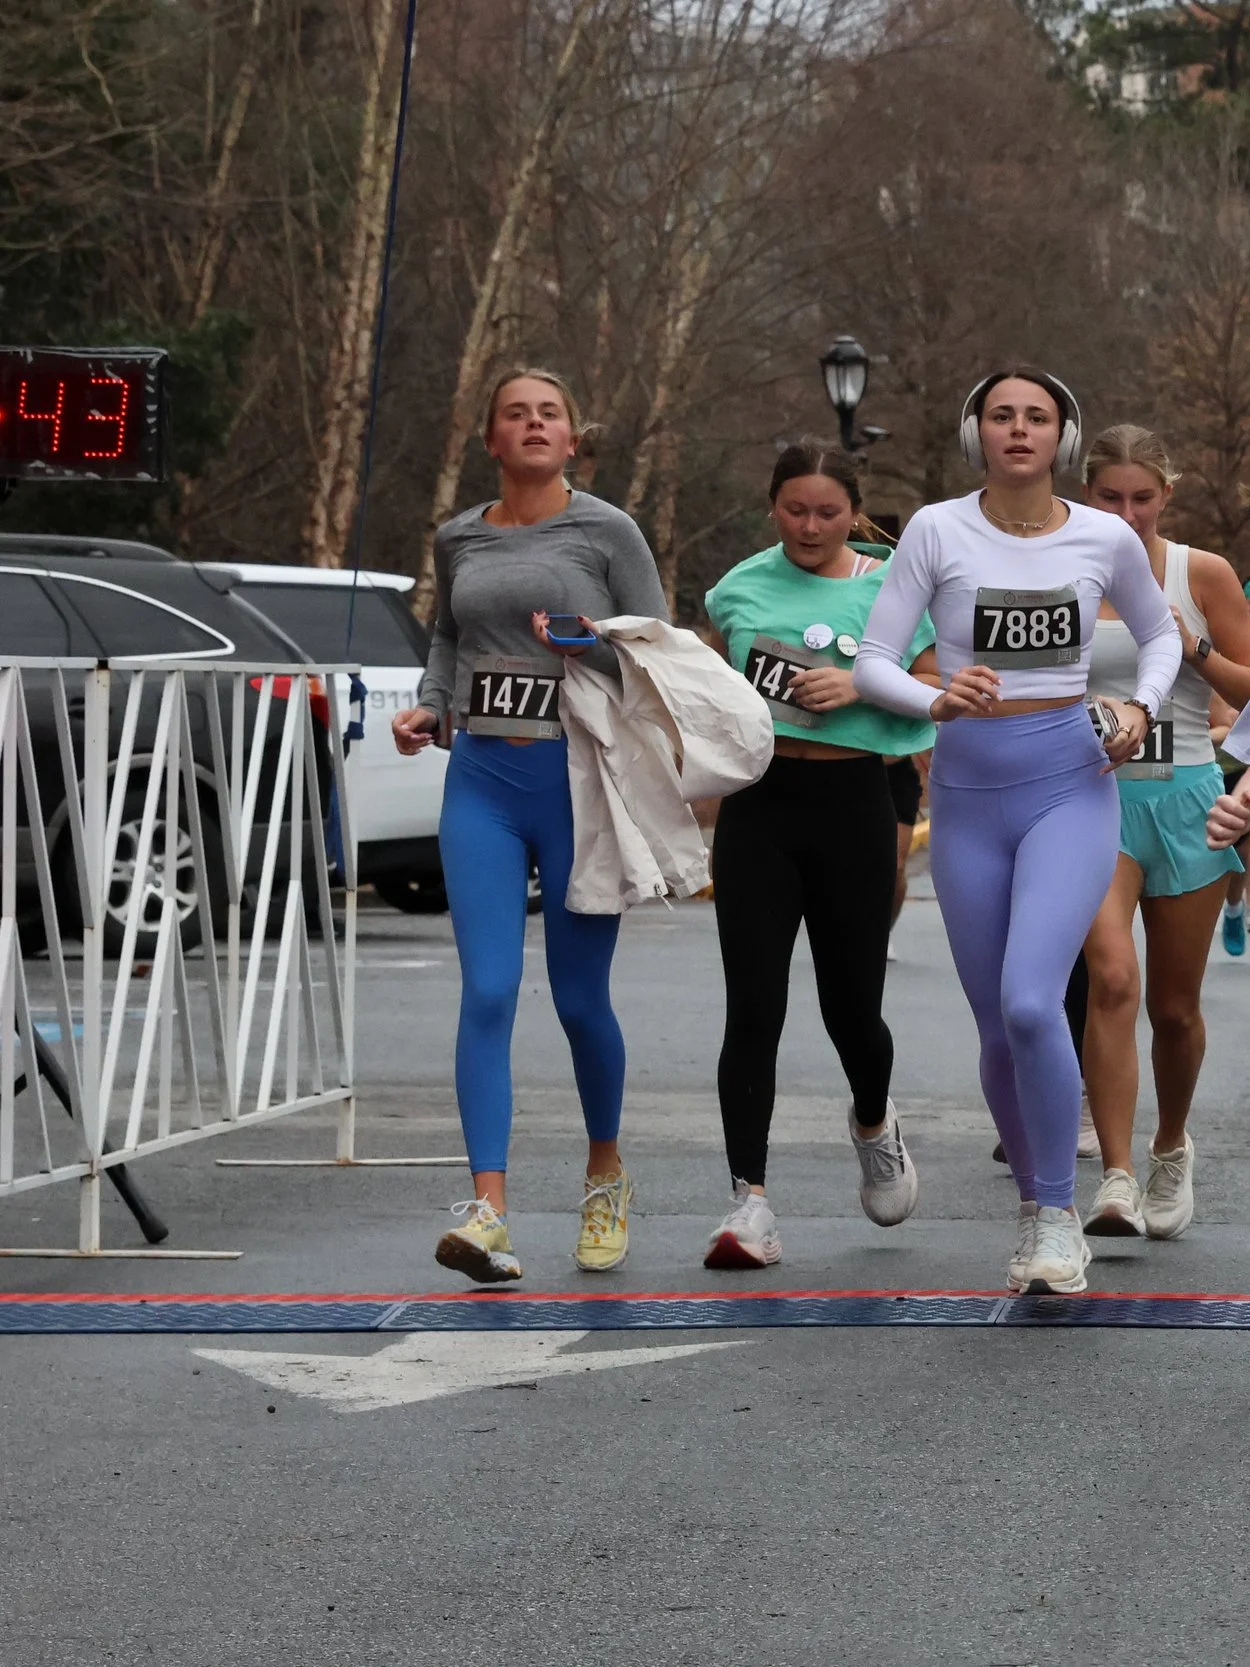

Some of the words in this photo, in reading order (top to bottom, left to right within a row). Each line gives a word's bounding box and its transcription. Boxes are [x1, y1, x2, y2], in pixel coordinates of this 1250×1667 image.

[983, 606, 1071, 649] 7883
[480, 675, 556, 717] 1477
[751, 655, 806, 702] 147
